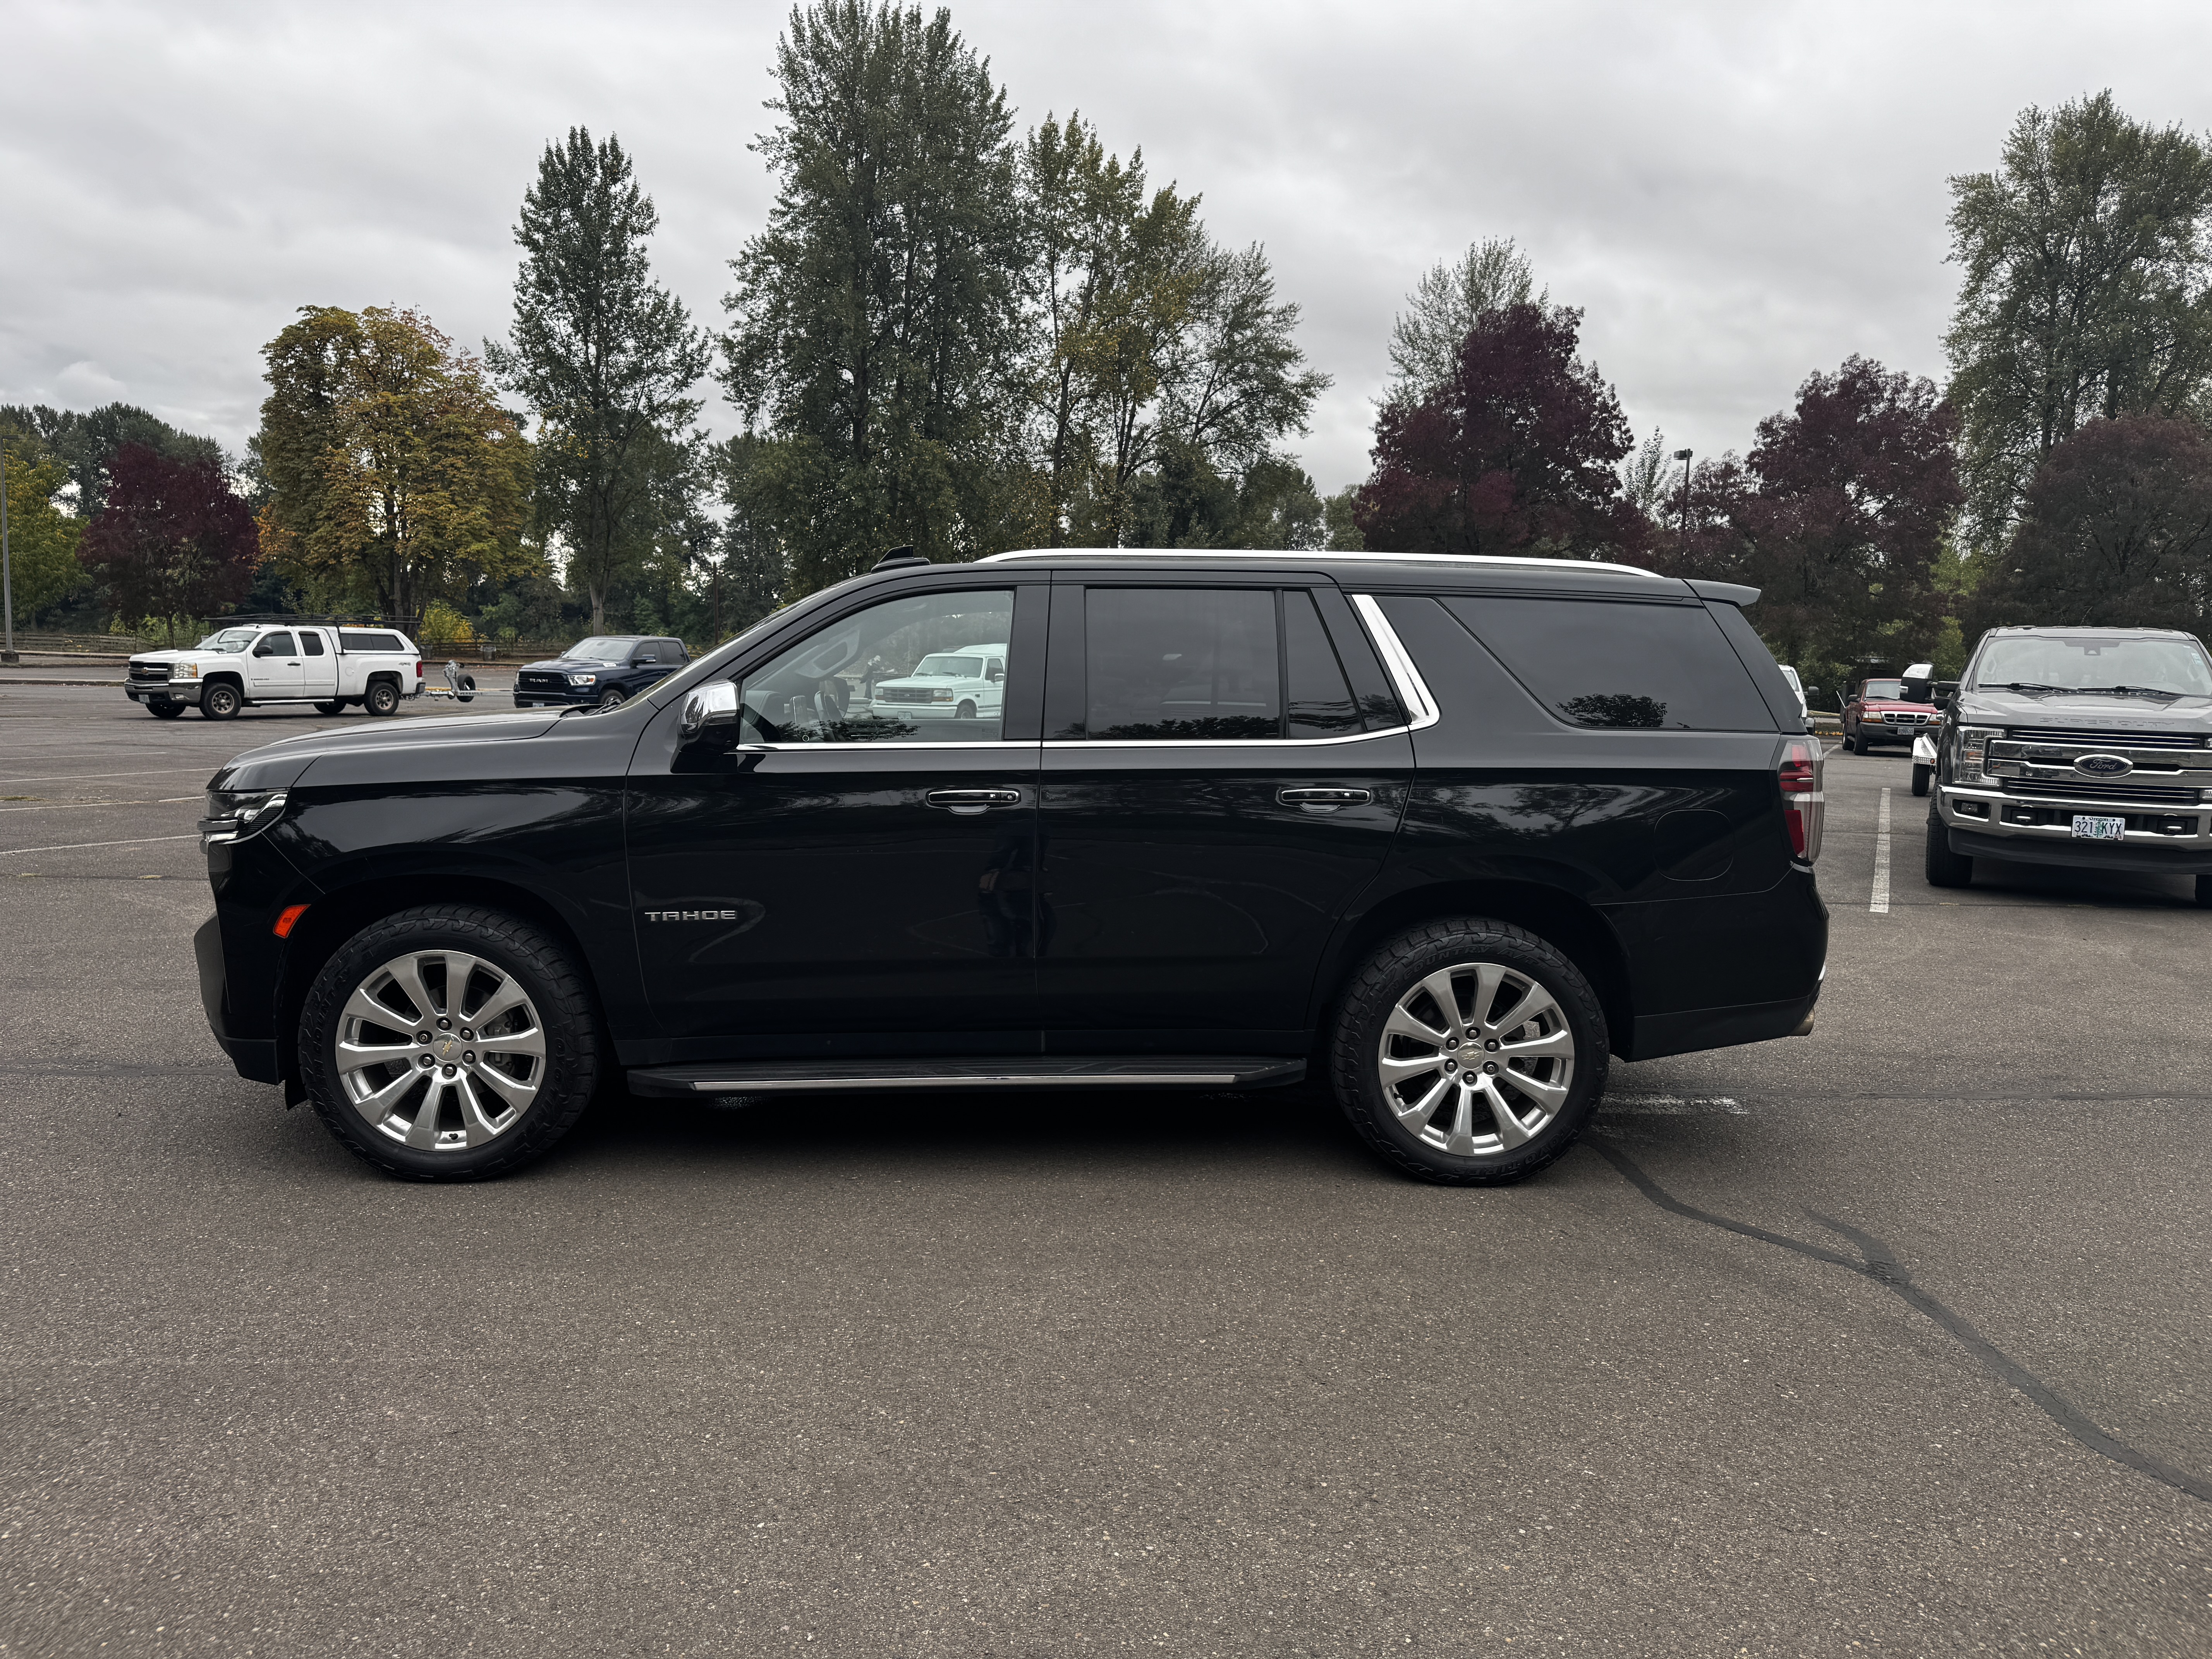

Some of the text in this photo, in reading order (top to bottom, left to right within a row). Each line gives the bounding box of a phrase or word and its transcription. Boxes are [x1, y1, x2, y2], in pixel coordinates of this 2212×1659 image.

[2089, 759, 2118, 770] Ford
[2075, 821, 2122, 835] 321 KYX
[644, 910, 737, 921] TAHOE
[1403, 945, 1494, 979] COUNTRY
[1524, 1123, 1570, 1164] TOYO
